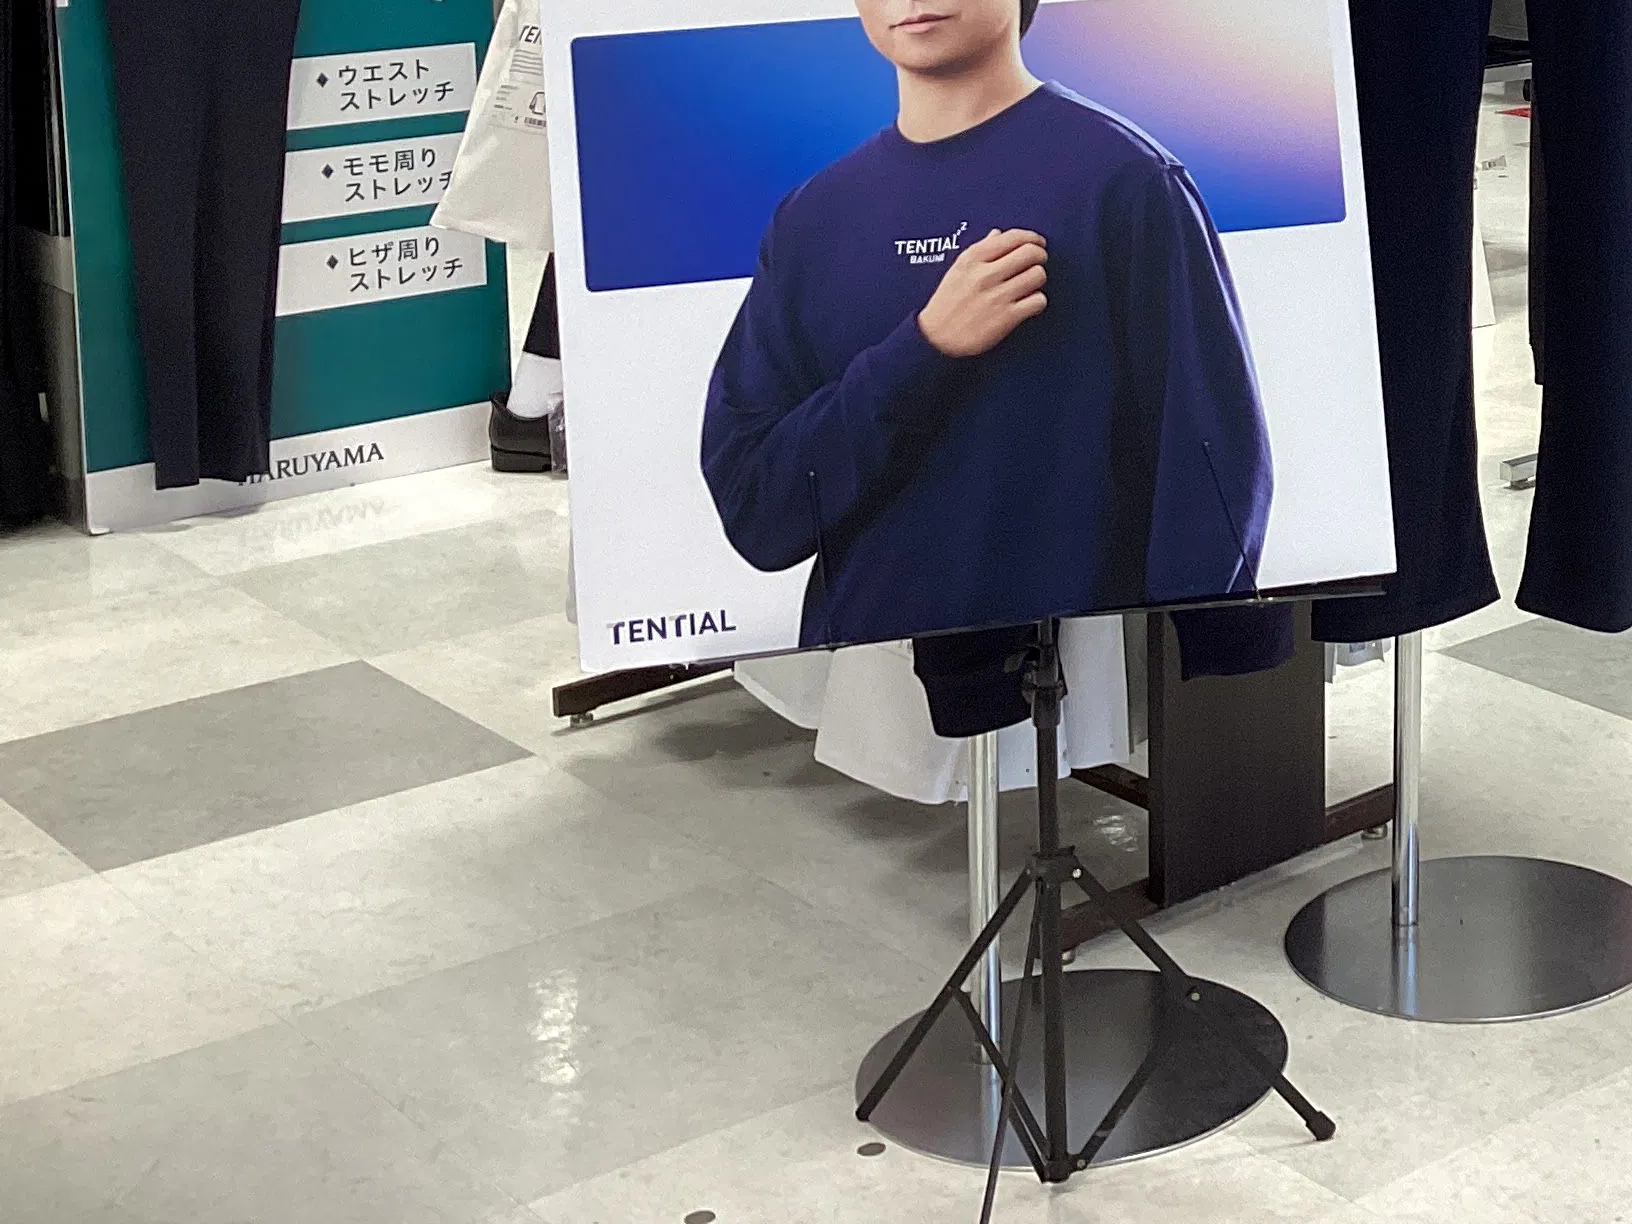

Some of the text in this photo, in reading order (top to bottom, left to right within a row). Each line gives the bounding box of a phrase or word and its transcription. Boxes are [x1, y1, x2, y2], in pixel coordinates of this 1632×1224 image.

[338, 58, 430, 84] ウエスト
[340, 79, 454, 112] ストレッチ
[343, 147, 437, 176] モモ周り
[348, 236, 441, 268] ヒザ周り
[894, 234, 960, 254] TENTIAL
[910, 253, 945, 264] BAKUNE
[350, 259, 463, 293] ストレッチ
[238, 442, 384, 485] RUYAMA
[606, 609, 737, 645] TENTIAL
